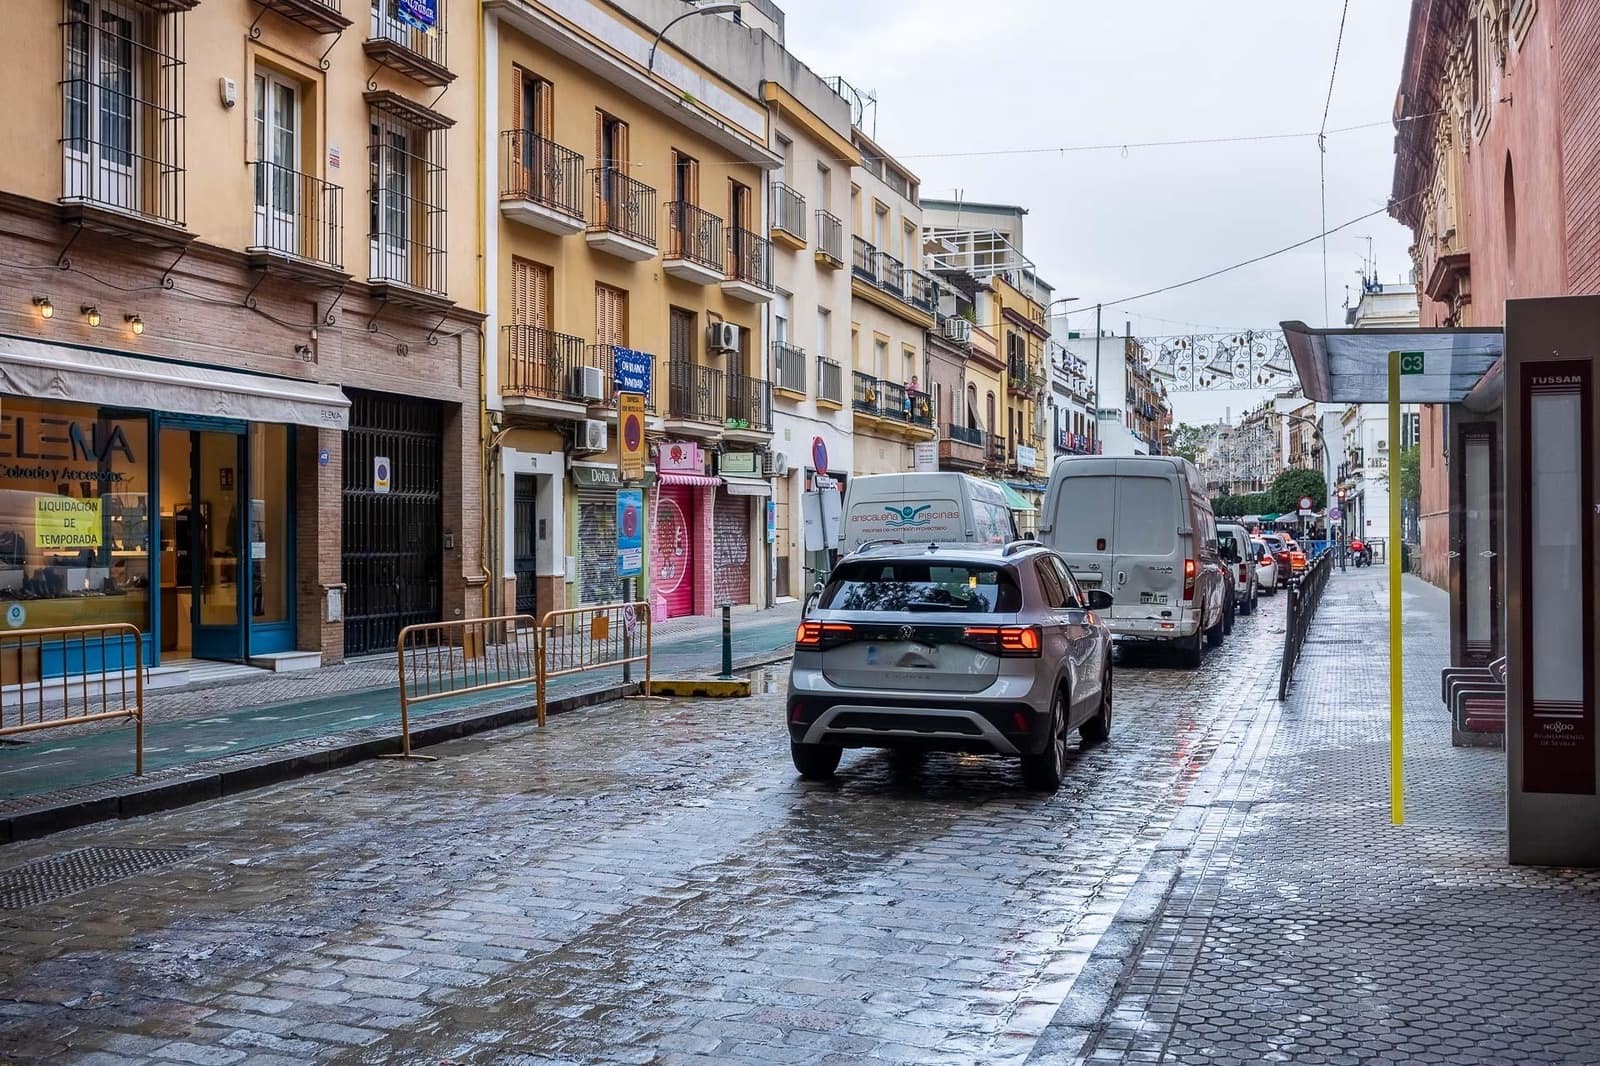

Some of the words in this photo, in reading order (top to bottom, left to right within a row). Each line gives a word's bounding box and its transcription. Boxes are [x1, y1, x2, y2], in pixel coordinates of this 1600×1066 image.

[396, 344, 409, 357] 60
[1402, 356, 1423, 370] C3
[1531, 376, 1581, 384] TUSSAM
[321, 410, 344, 419] ELENA
[592, 469, 610, 482] Doña
[38, 500, 98, 512] LIQUIDACIÓN
[63, 518, 76, 528] DE
[40, 534, 98, 545] TEMPORADA
